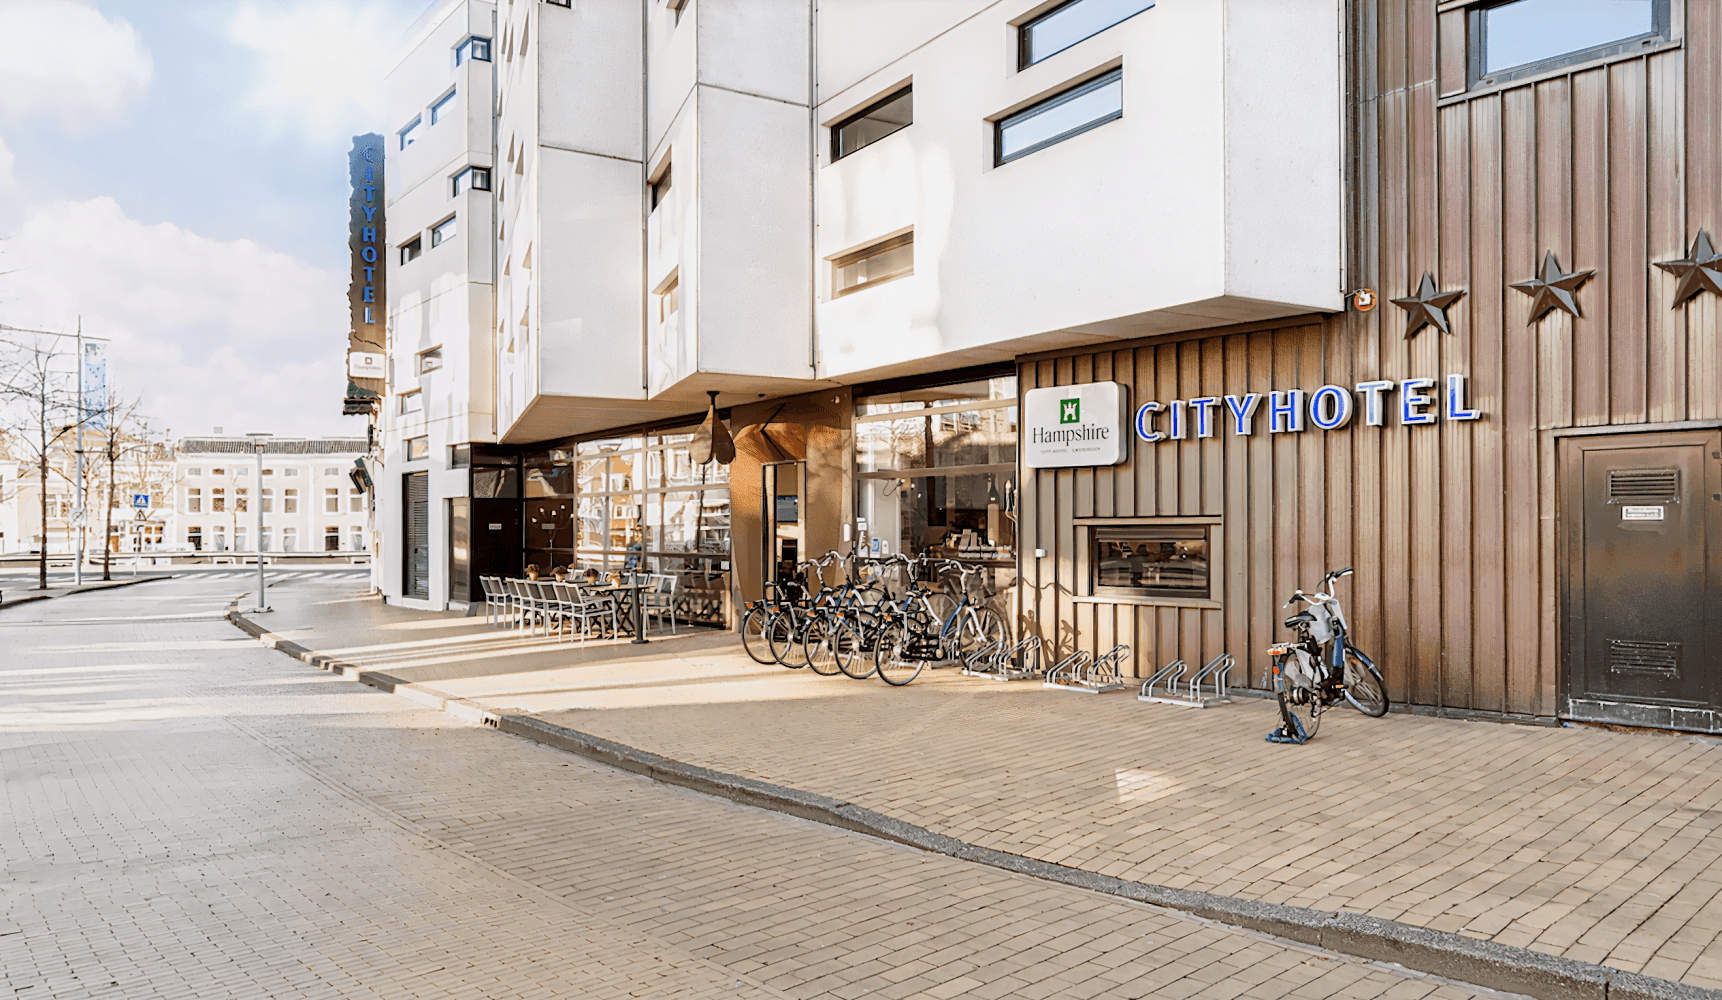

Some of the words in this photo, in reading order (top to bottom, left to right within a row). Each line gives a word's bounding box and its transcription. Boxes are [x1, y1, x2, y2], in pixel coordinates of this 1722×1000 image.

[361, 146, 379, 324] CITYHOTEL
[1032, 423, 1110, 447] Hampshire
[1135, 373, 1481, 443] CITYHOTEL
